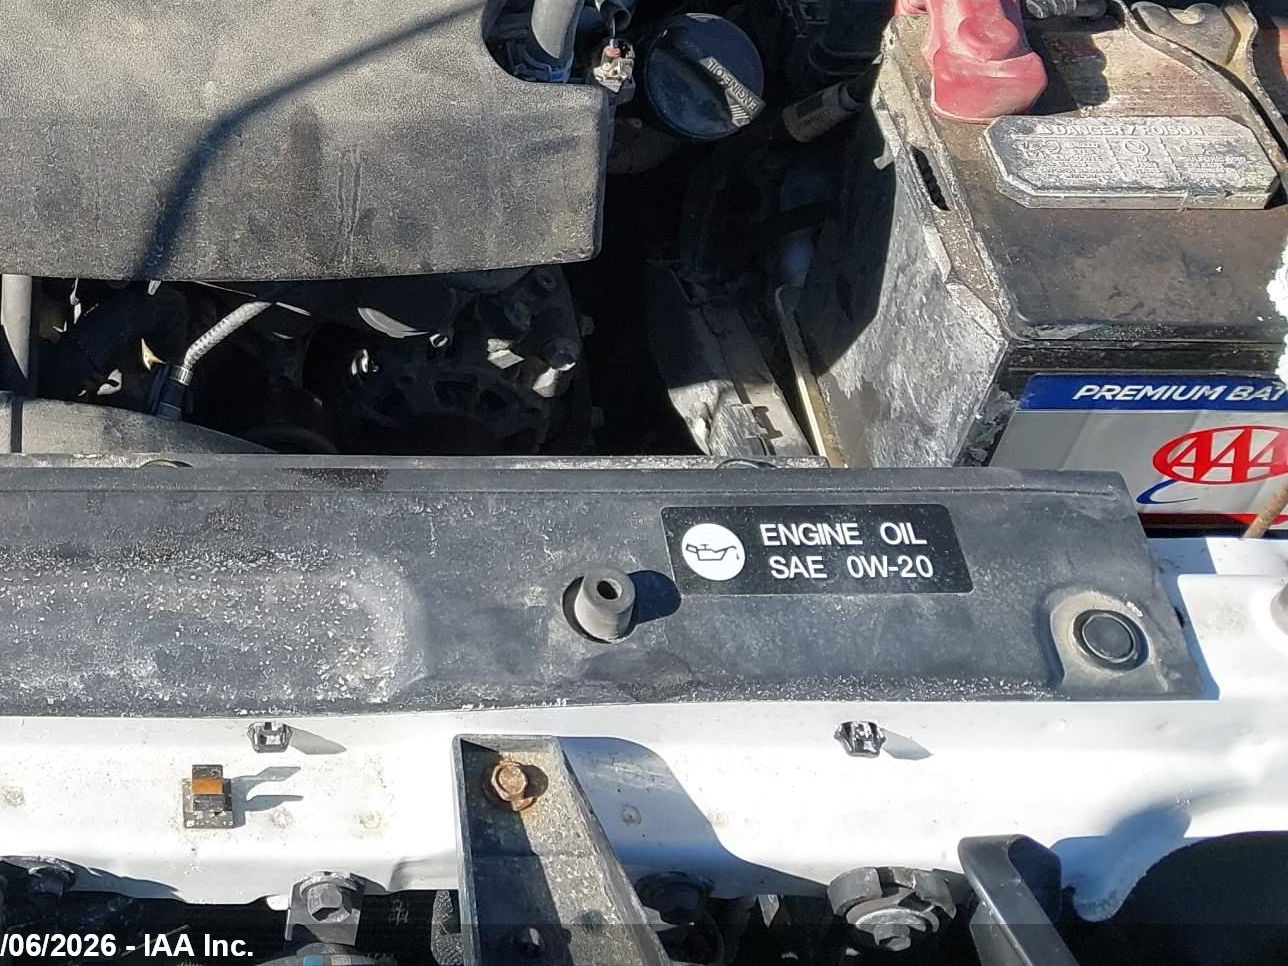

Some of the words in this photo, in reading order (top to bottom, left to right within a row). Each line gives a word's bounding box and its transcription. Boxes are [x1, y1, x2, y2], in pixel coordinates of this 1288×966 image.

[707, 58, 725, 78] OIL
[720, 75, 760, 112] ENGINE
[1053, 125, 1123, 136] DANGER
[1141, 125, 1206, 136] POISON
[1072, 385, 1228, 401] PREMIUM
[1168, 427, 1288, 482] AAA
[759, 522, 863, 546] ENGINE
[879, 522, 928, 545] OIL
[769, 555, 828, 579] SAE
[846, 555, 934, 578] 0W-20
